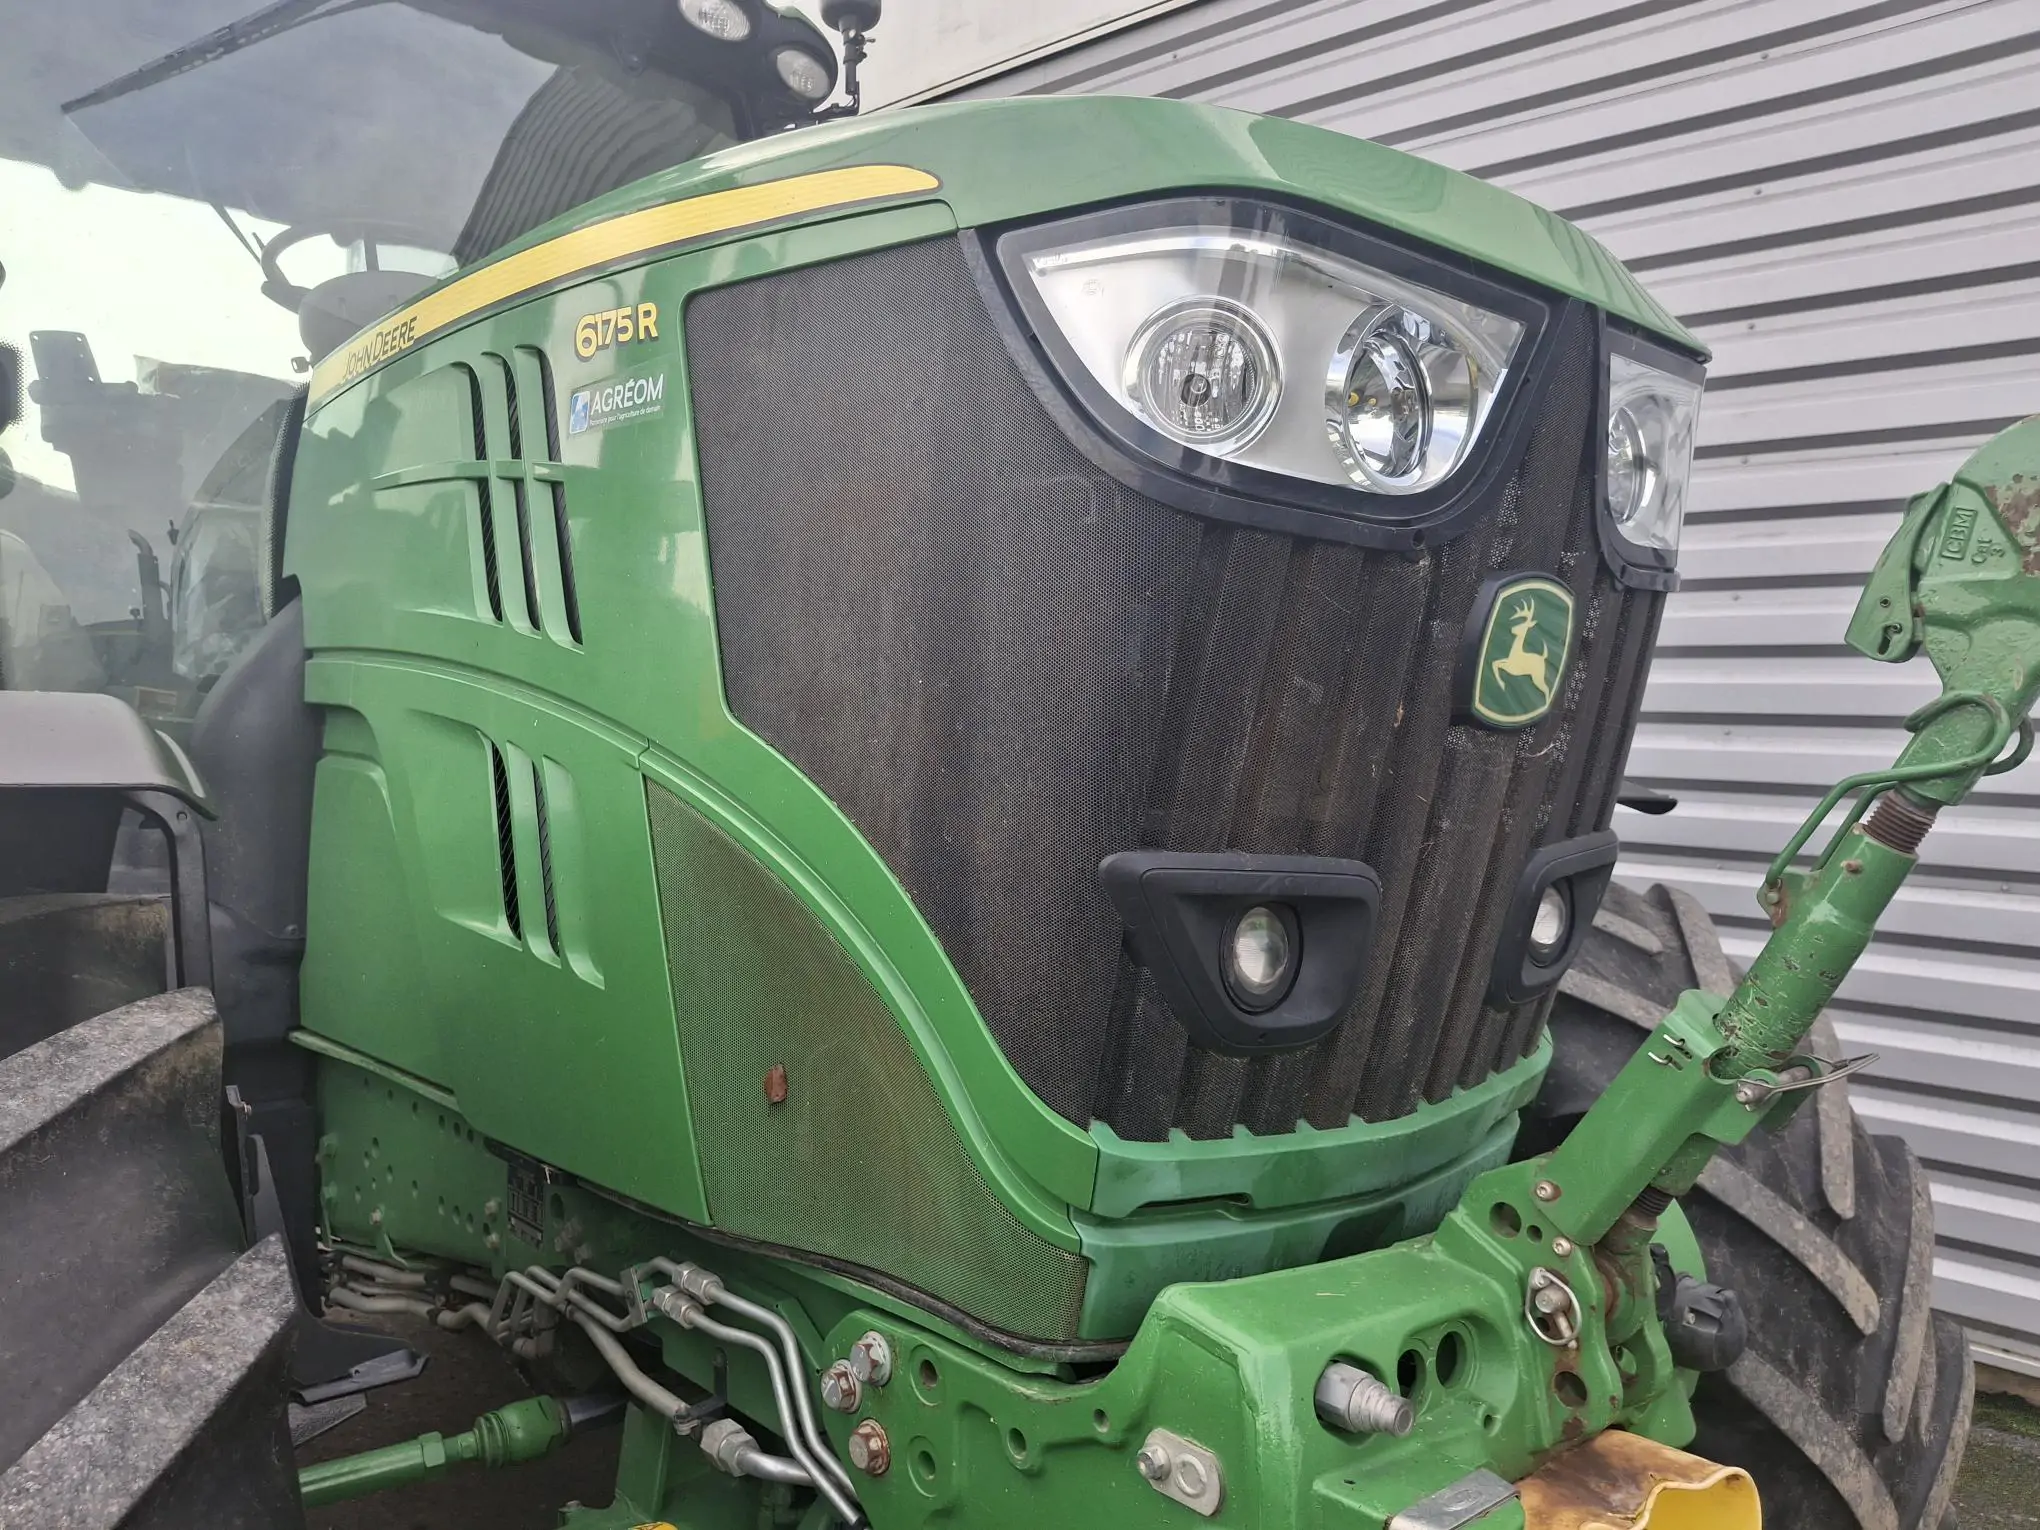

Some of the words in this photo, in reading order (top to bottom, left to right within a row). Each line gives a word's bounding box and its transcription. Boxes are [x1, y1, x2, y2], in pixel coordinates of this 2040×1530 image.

[343, 340, 374, 378] JOHN
[372, 315, 418, 362] DEERE
[590, 373, 663, 415] AGRÉOM
[1946, 513, 1973, 552] CBM
